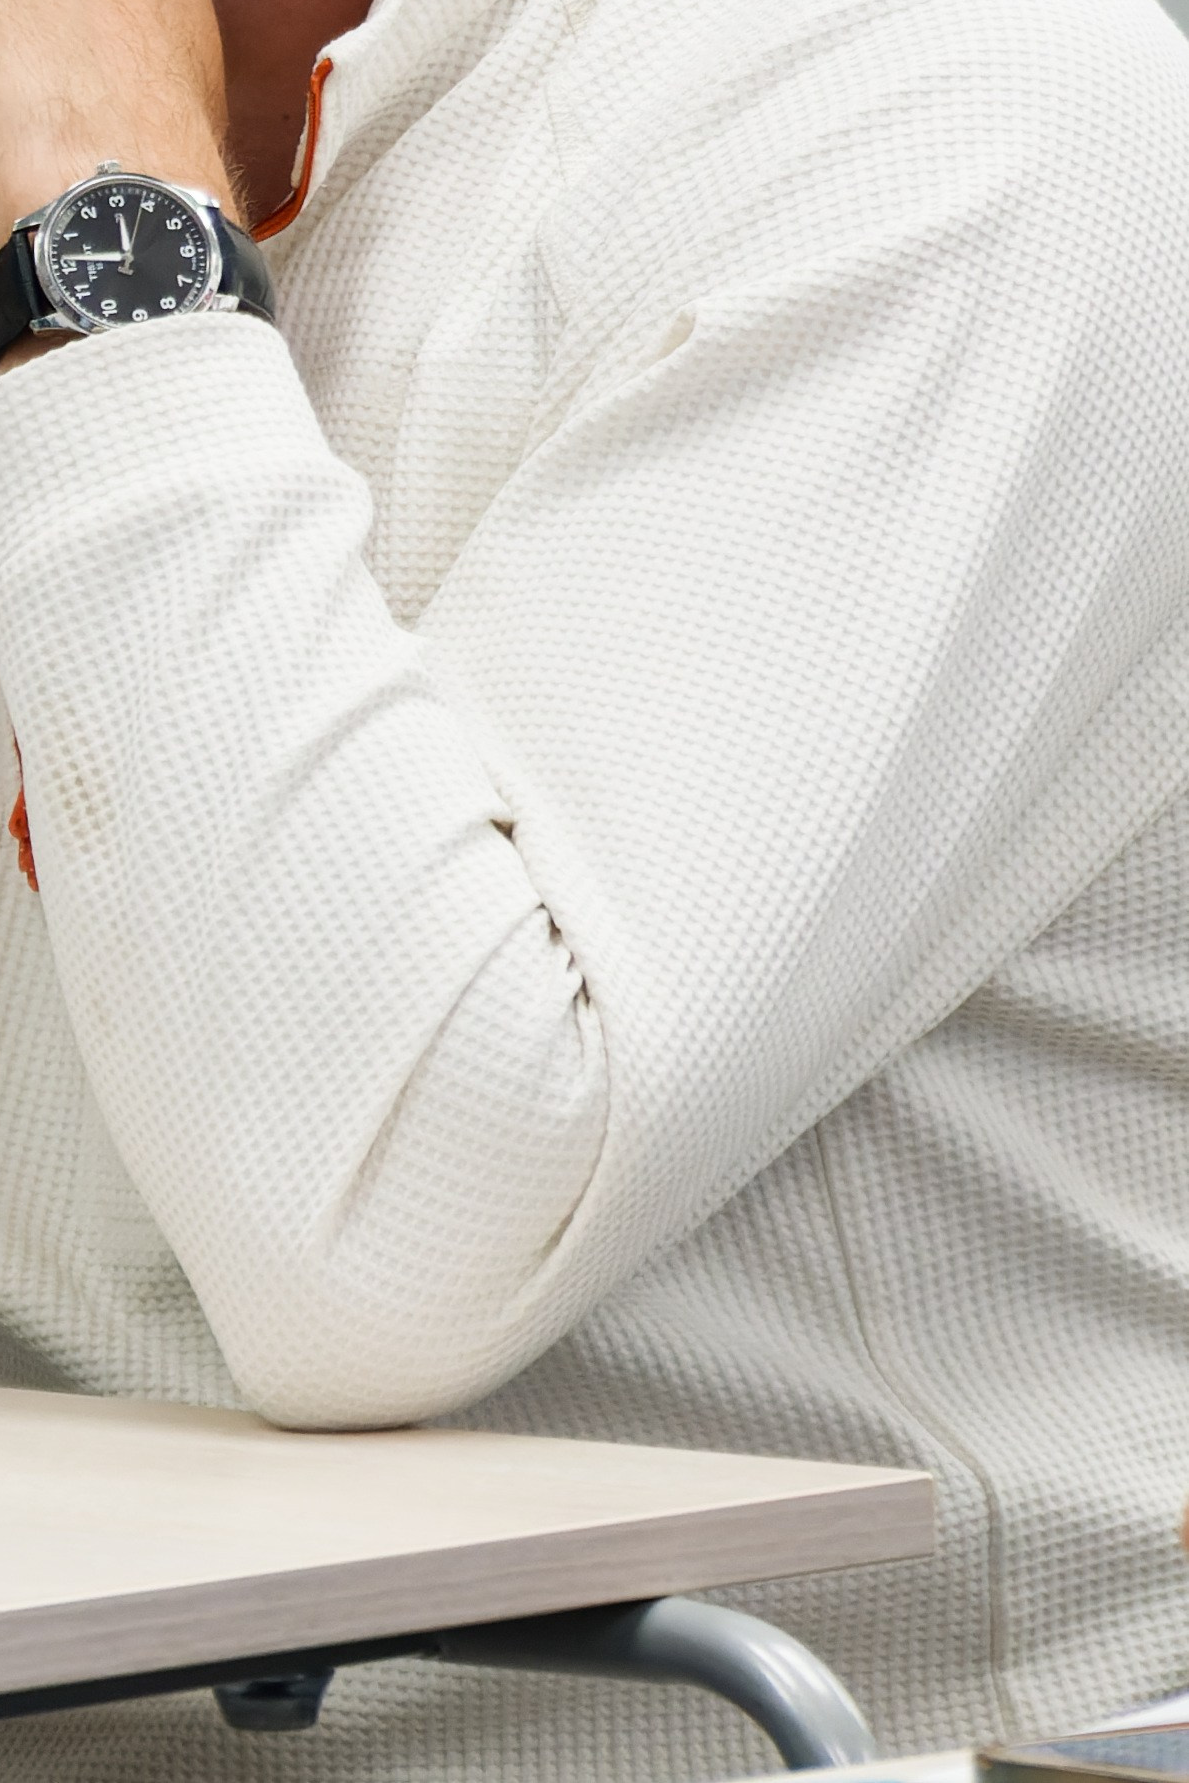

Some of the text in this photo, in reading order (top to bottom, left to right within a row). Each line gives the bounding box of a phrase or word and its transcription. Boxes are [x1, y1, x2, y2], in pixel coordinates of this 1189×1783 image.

[108, 195, 125, 207] 3
[139, 200, 156, 213] 4
[80, 206, 97, 220] 2
[165, 218, 182, 230] 5
[62, 232, 79, 241] 1
[179, 245, 196, 258] 6
[59, 256, 78, 275] 12
[176, 274, 193, 287] 7
[73, 284, 91, 300] 11
[100, 299, 118, 317] 10
[159, 296, 176, 309] 8
[131, 308, 149, 322] 9
